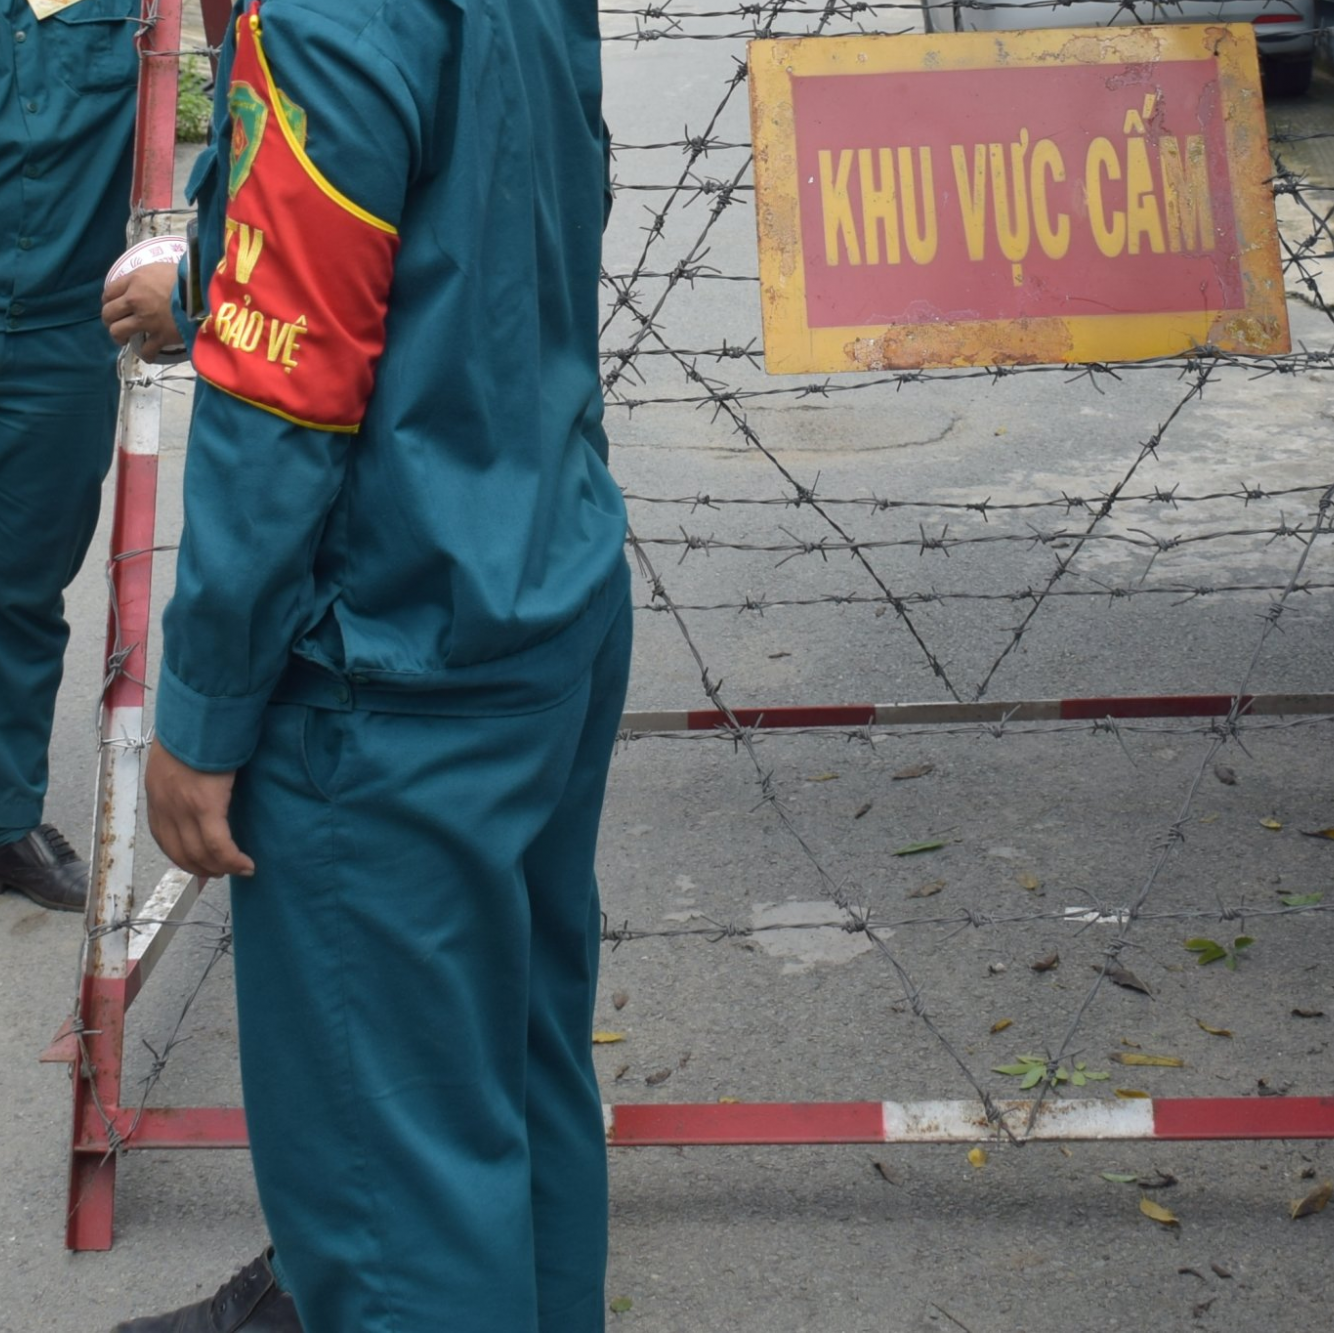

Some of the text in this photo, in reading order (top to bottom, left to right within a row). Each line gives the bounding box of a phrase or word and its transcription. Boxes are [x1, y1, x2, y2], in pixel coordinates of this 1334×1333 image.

[818, 93, 1216, 287] KHU VỰC CẤM
[216, 294, 308, 374] BẢO VỆ
